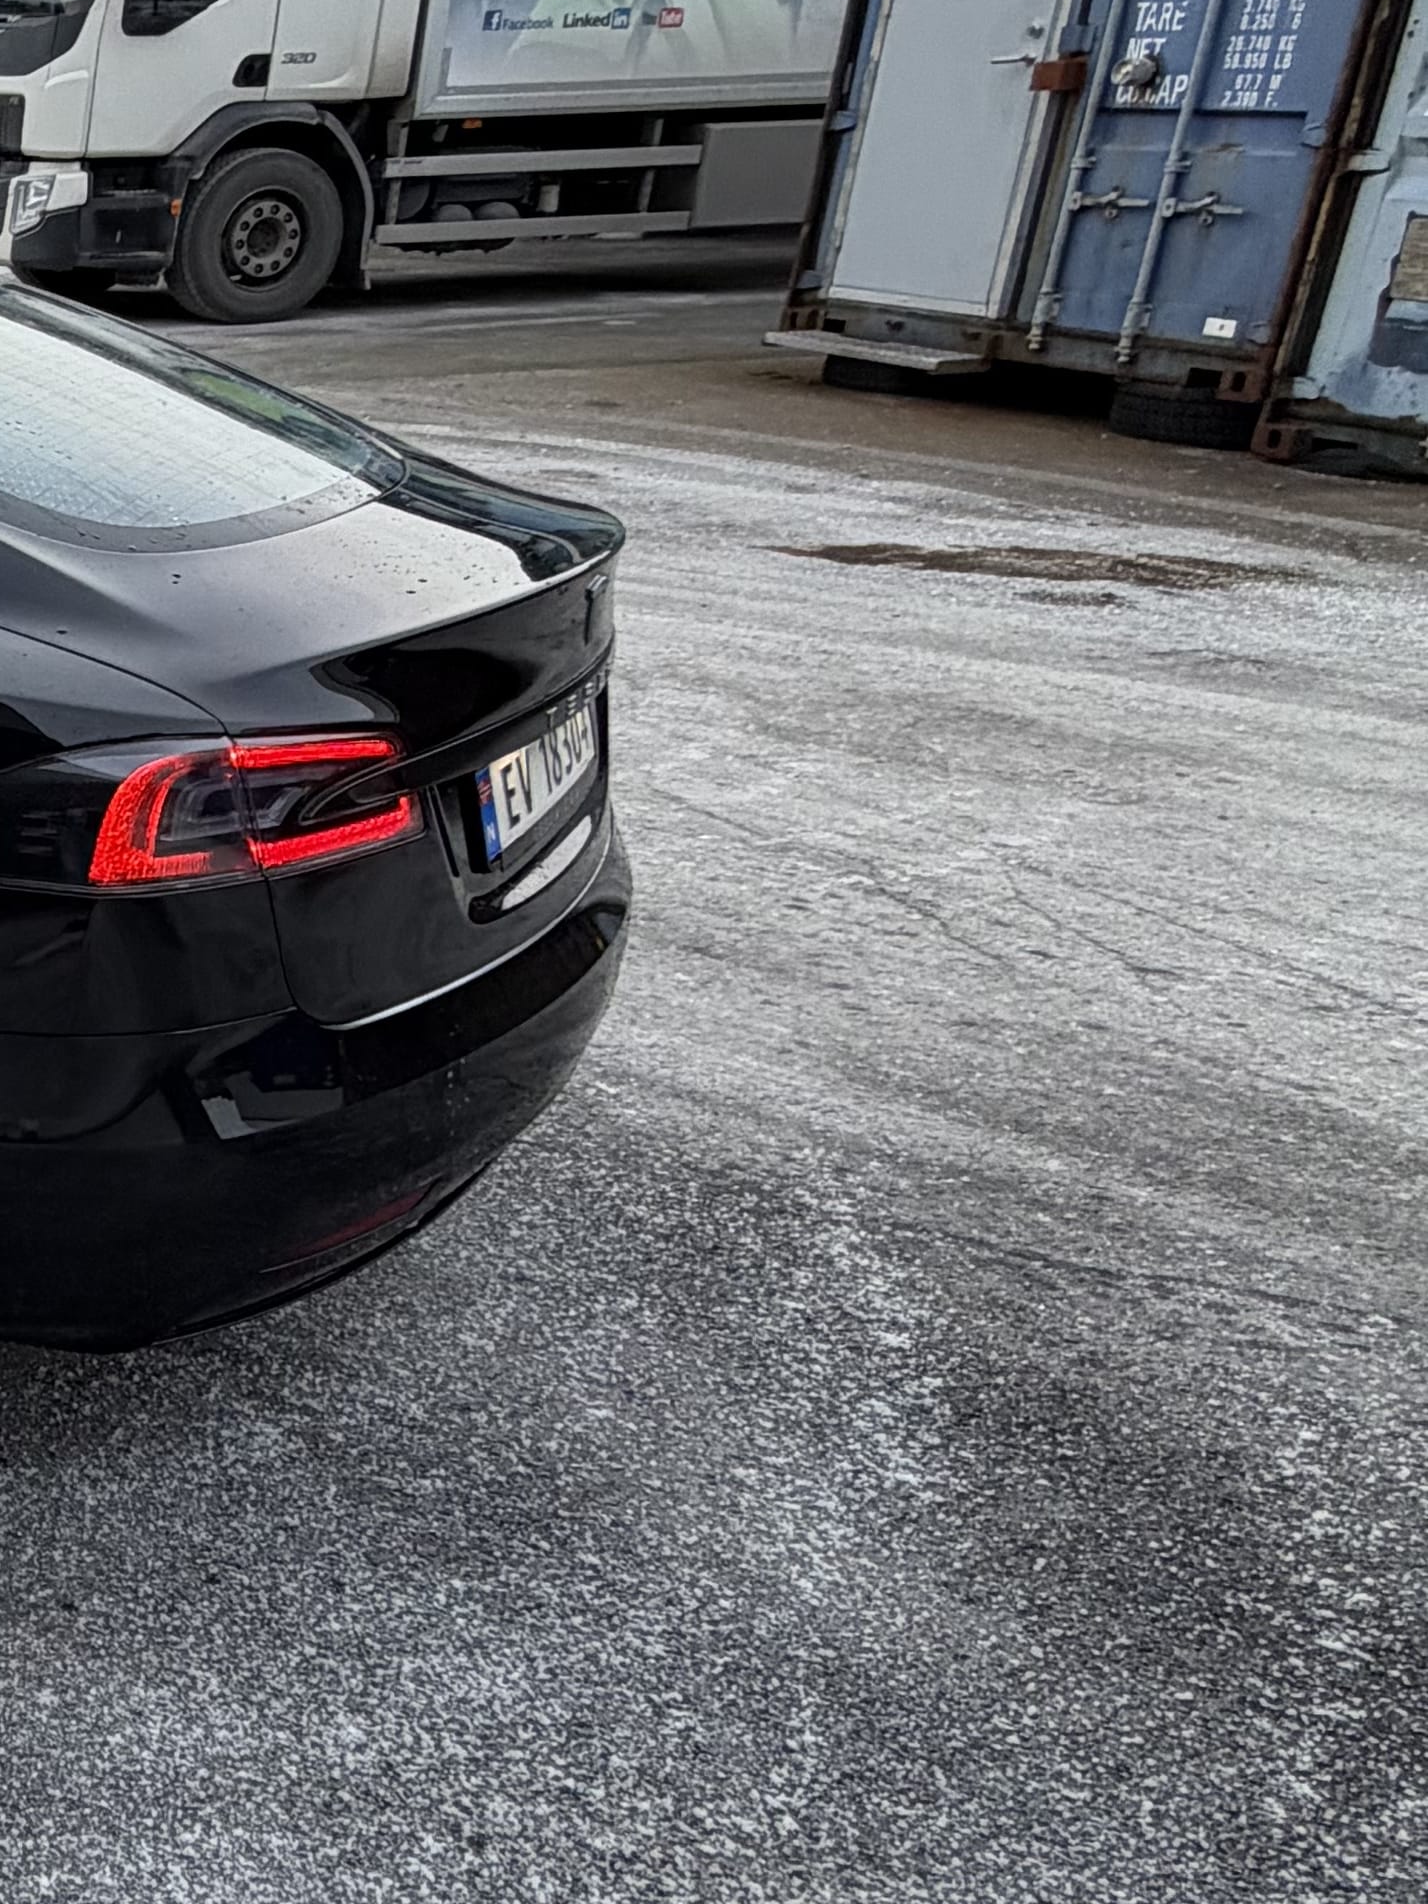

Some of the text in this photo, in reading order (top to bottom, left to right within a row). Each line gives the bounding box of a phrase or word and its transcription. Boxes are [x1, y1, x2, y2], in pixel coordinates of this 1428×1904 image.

[502, 16, 553, 31] Facebook
[1135, 0, 1189, 32] TARE
[1126, 37, 1167, 59] NET
[501, 748, 532, 830] EV
